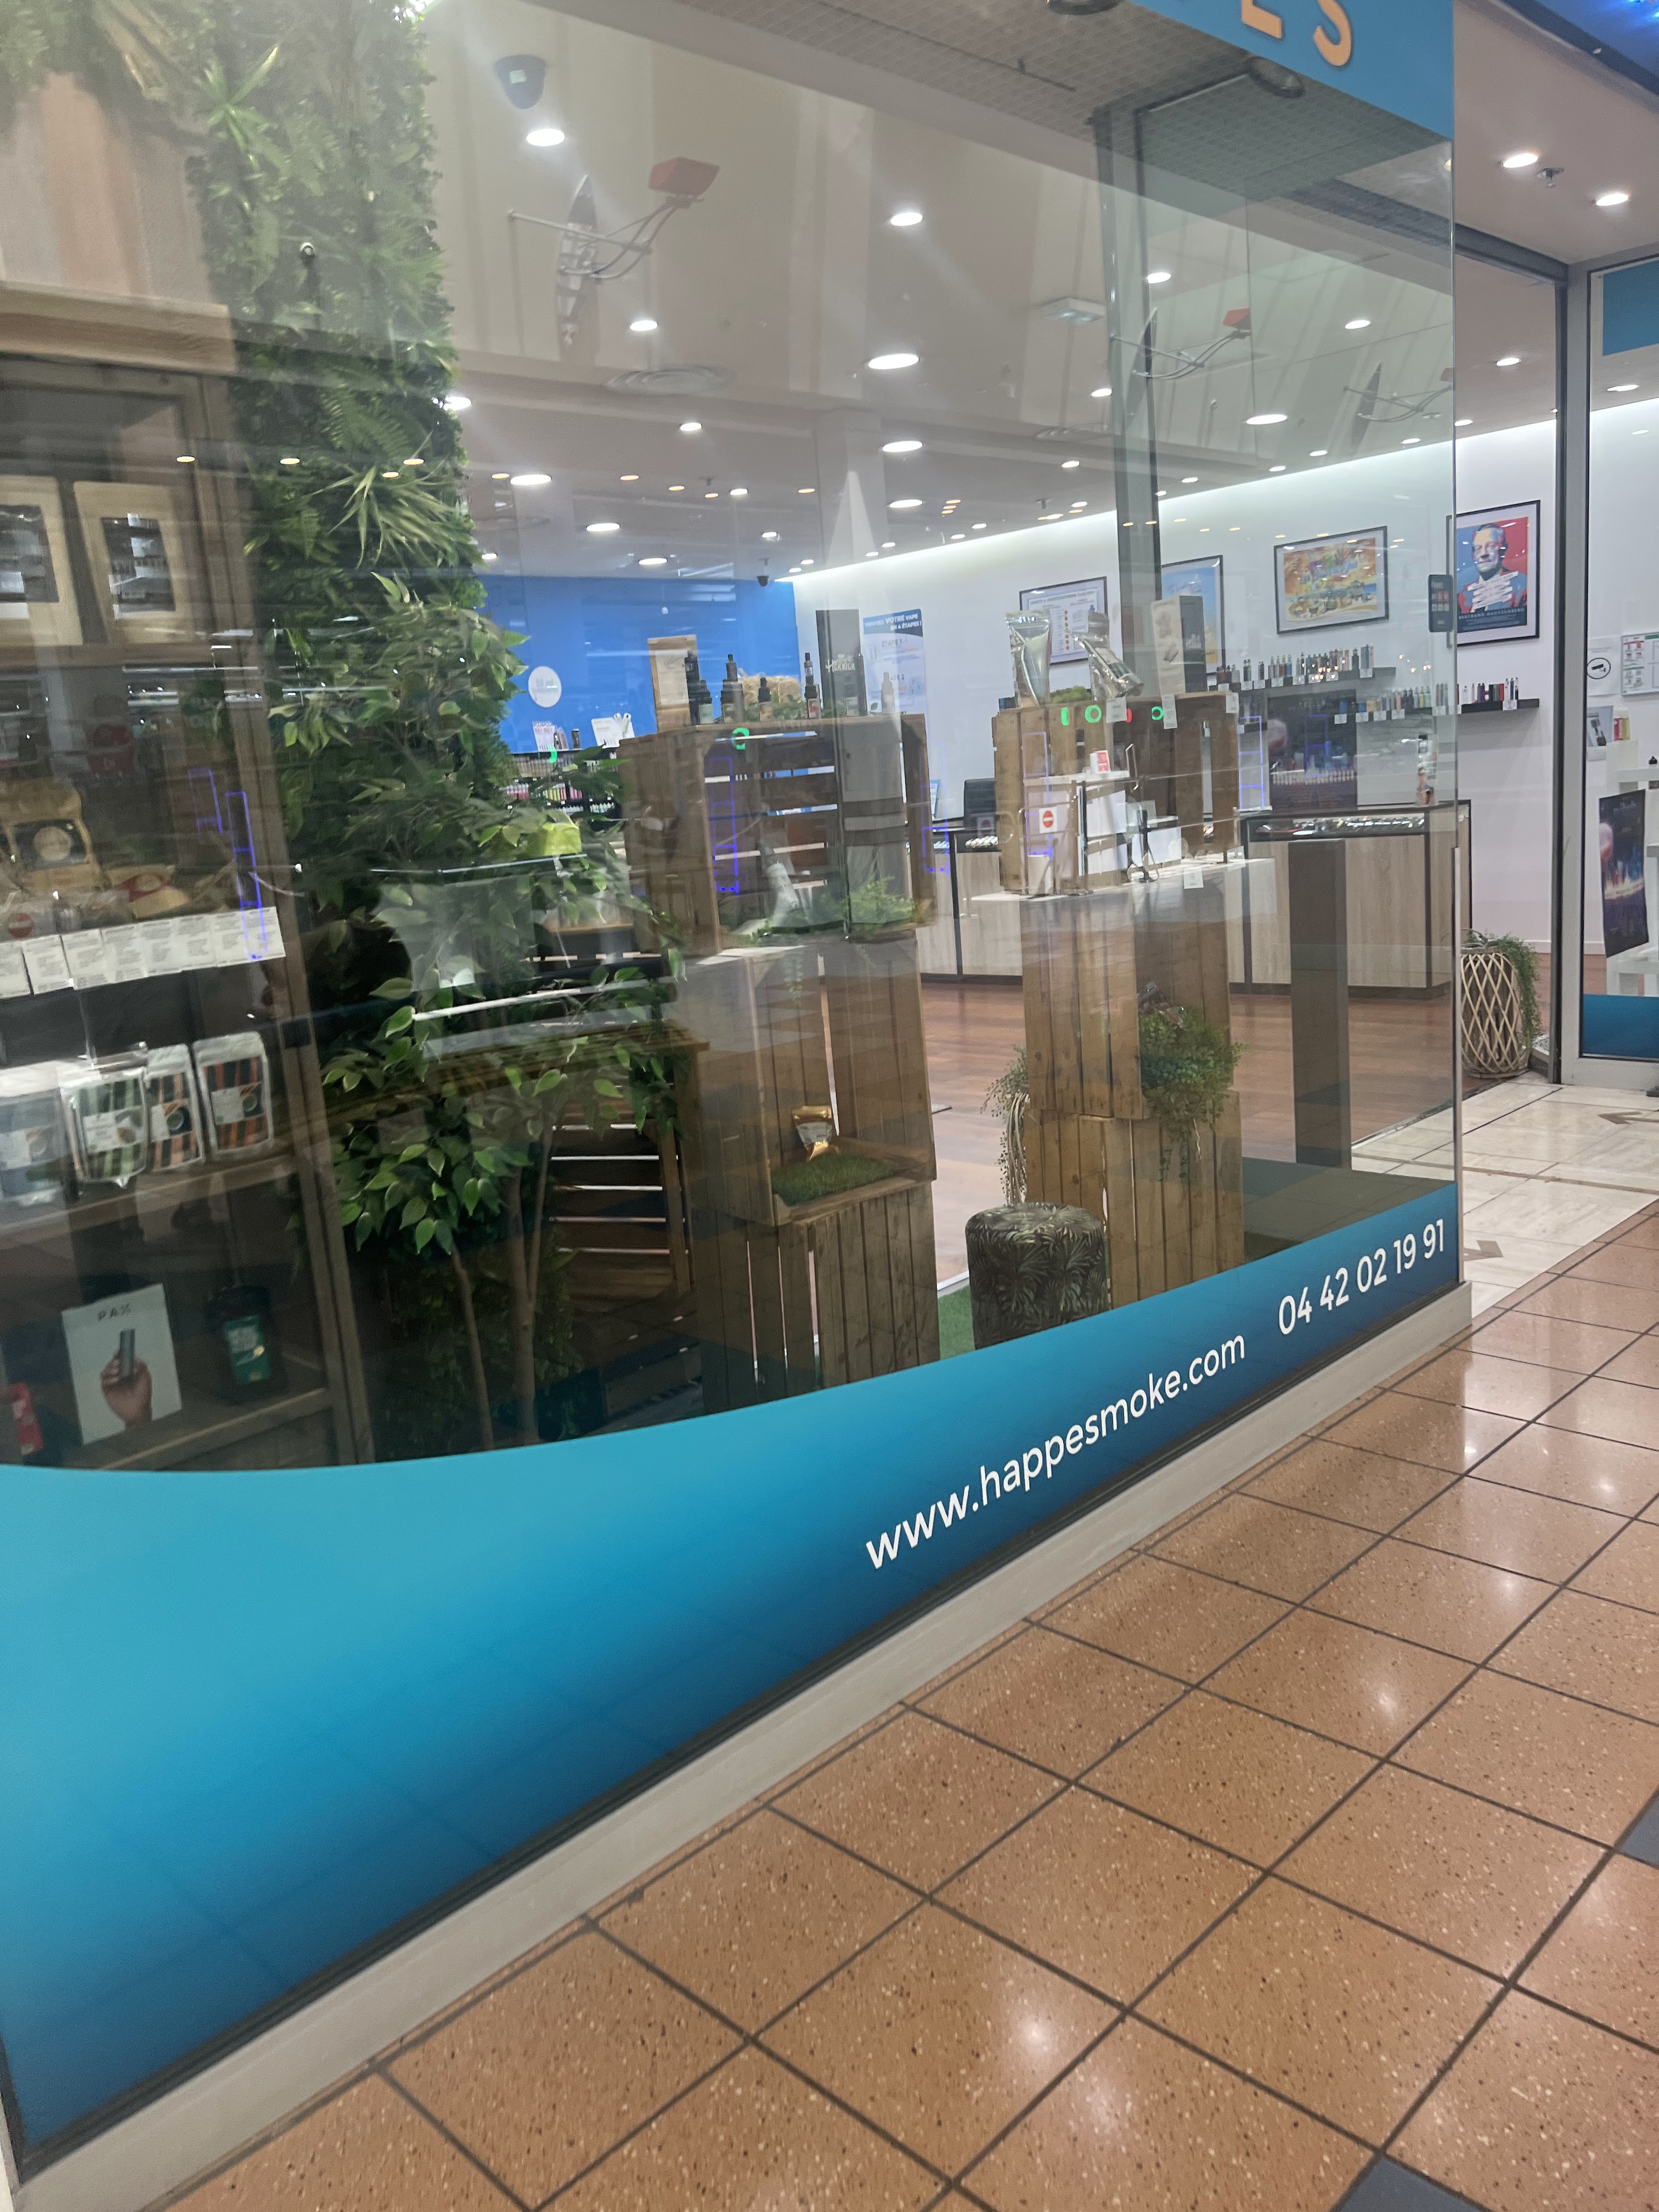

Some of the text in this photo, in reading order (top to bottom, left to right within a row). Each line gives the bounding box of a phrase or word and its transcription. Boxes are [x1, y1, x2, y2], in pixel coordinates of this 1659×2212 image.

[885, 615, 905, 624] VOTRE
[1279, 1218, 1445, 1335] 04 42 02 19 91
[866, 1335, 1245, 1569] www.happesmoke.com
